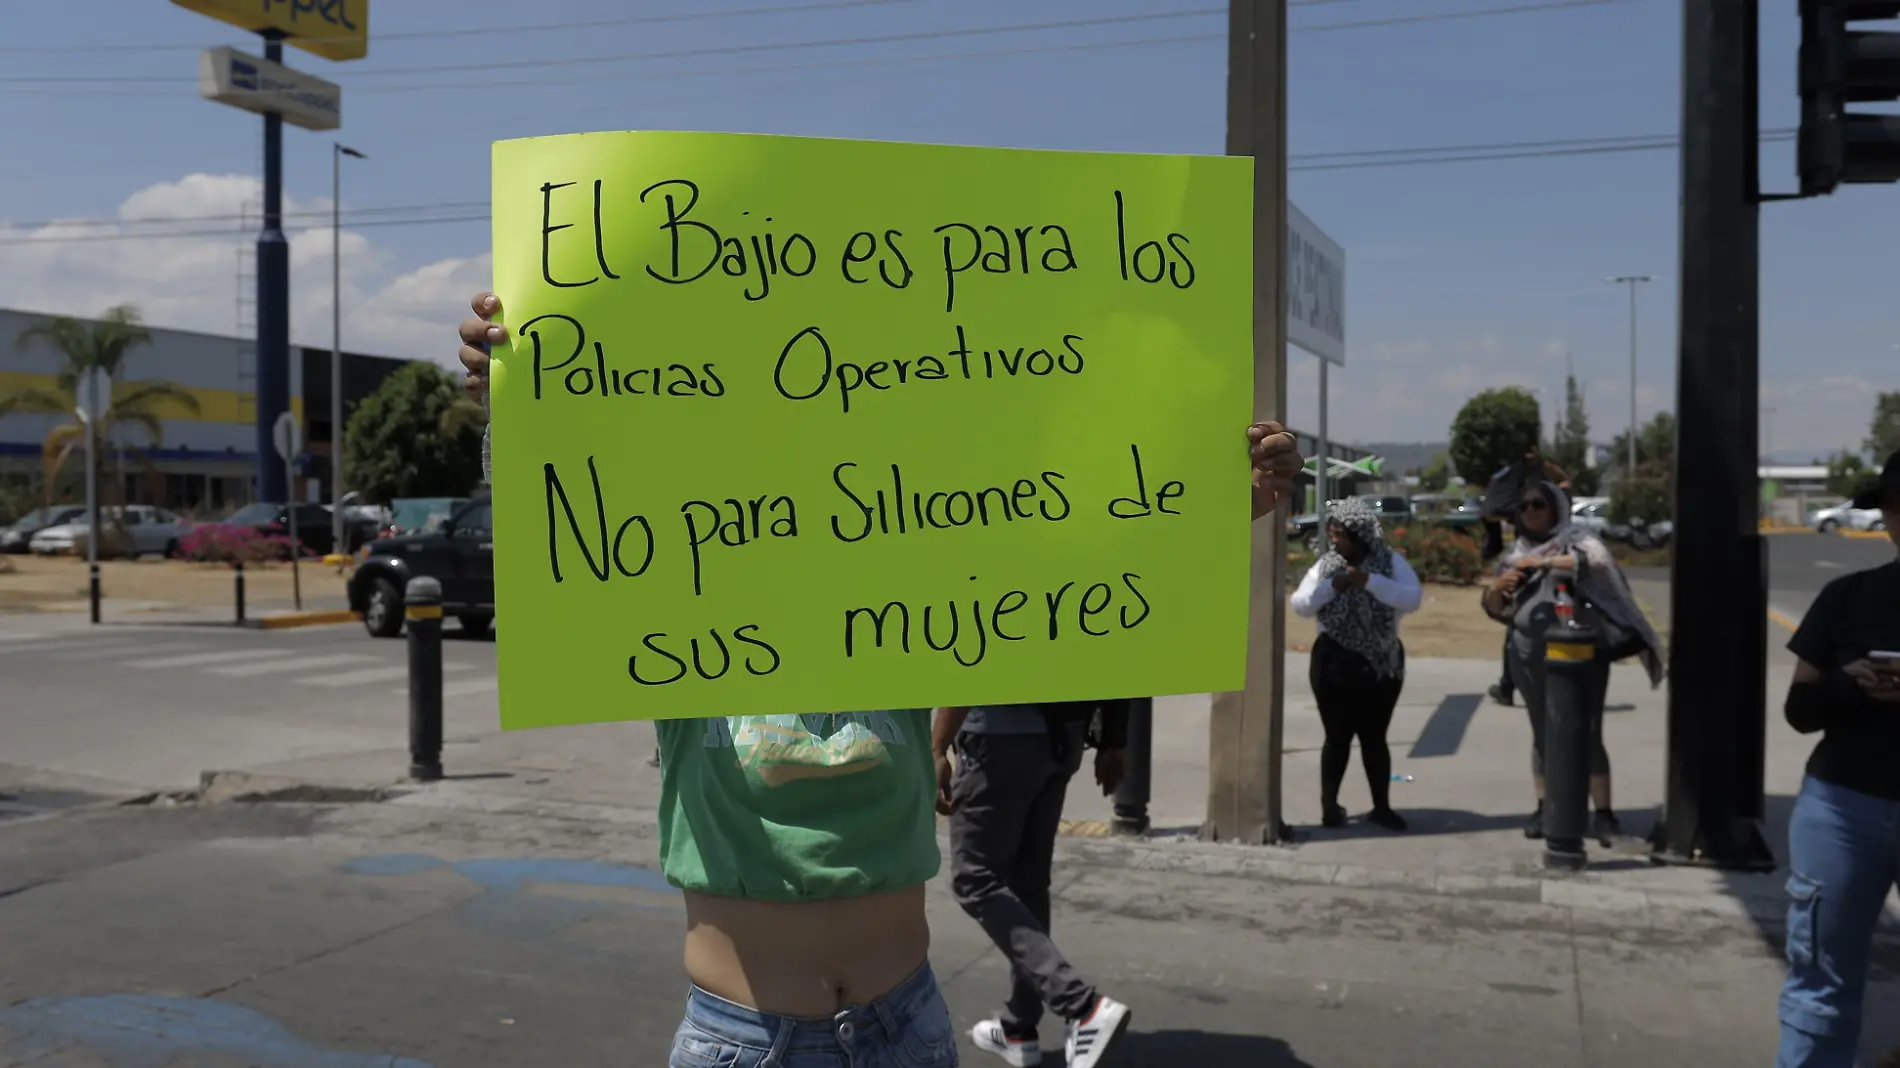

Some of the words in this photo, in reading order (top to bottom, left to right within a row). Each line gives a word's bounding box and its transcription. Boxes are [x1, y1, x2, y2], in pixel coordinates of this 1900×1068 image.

[539, 179, 621, 288] El
[639, 179, 817, 302] Bajio
[840, 228, 914, 290] es
[933, 222, 1078, 313] para
[1113, 189, 1196, 290] los
[518, 313, 726, 401] Policias
[773, 325, 1084, 414] Operativos
[543, 454, 655, 584] No
[680, 494, 799, 597] para
[830, 461, 1071, 543] Silicones
[1107, 443, 1186, 520] de
[627, 623, 781, 689] sus
[844, 572, 1152, 668] mujeres
